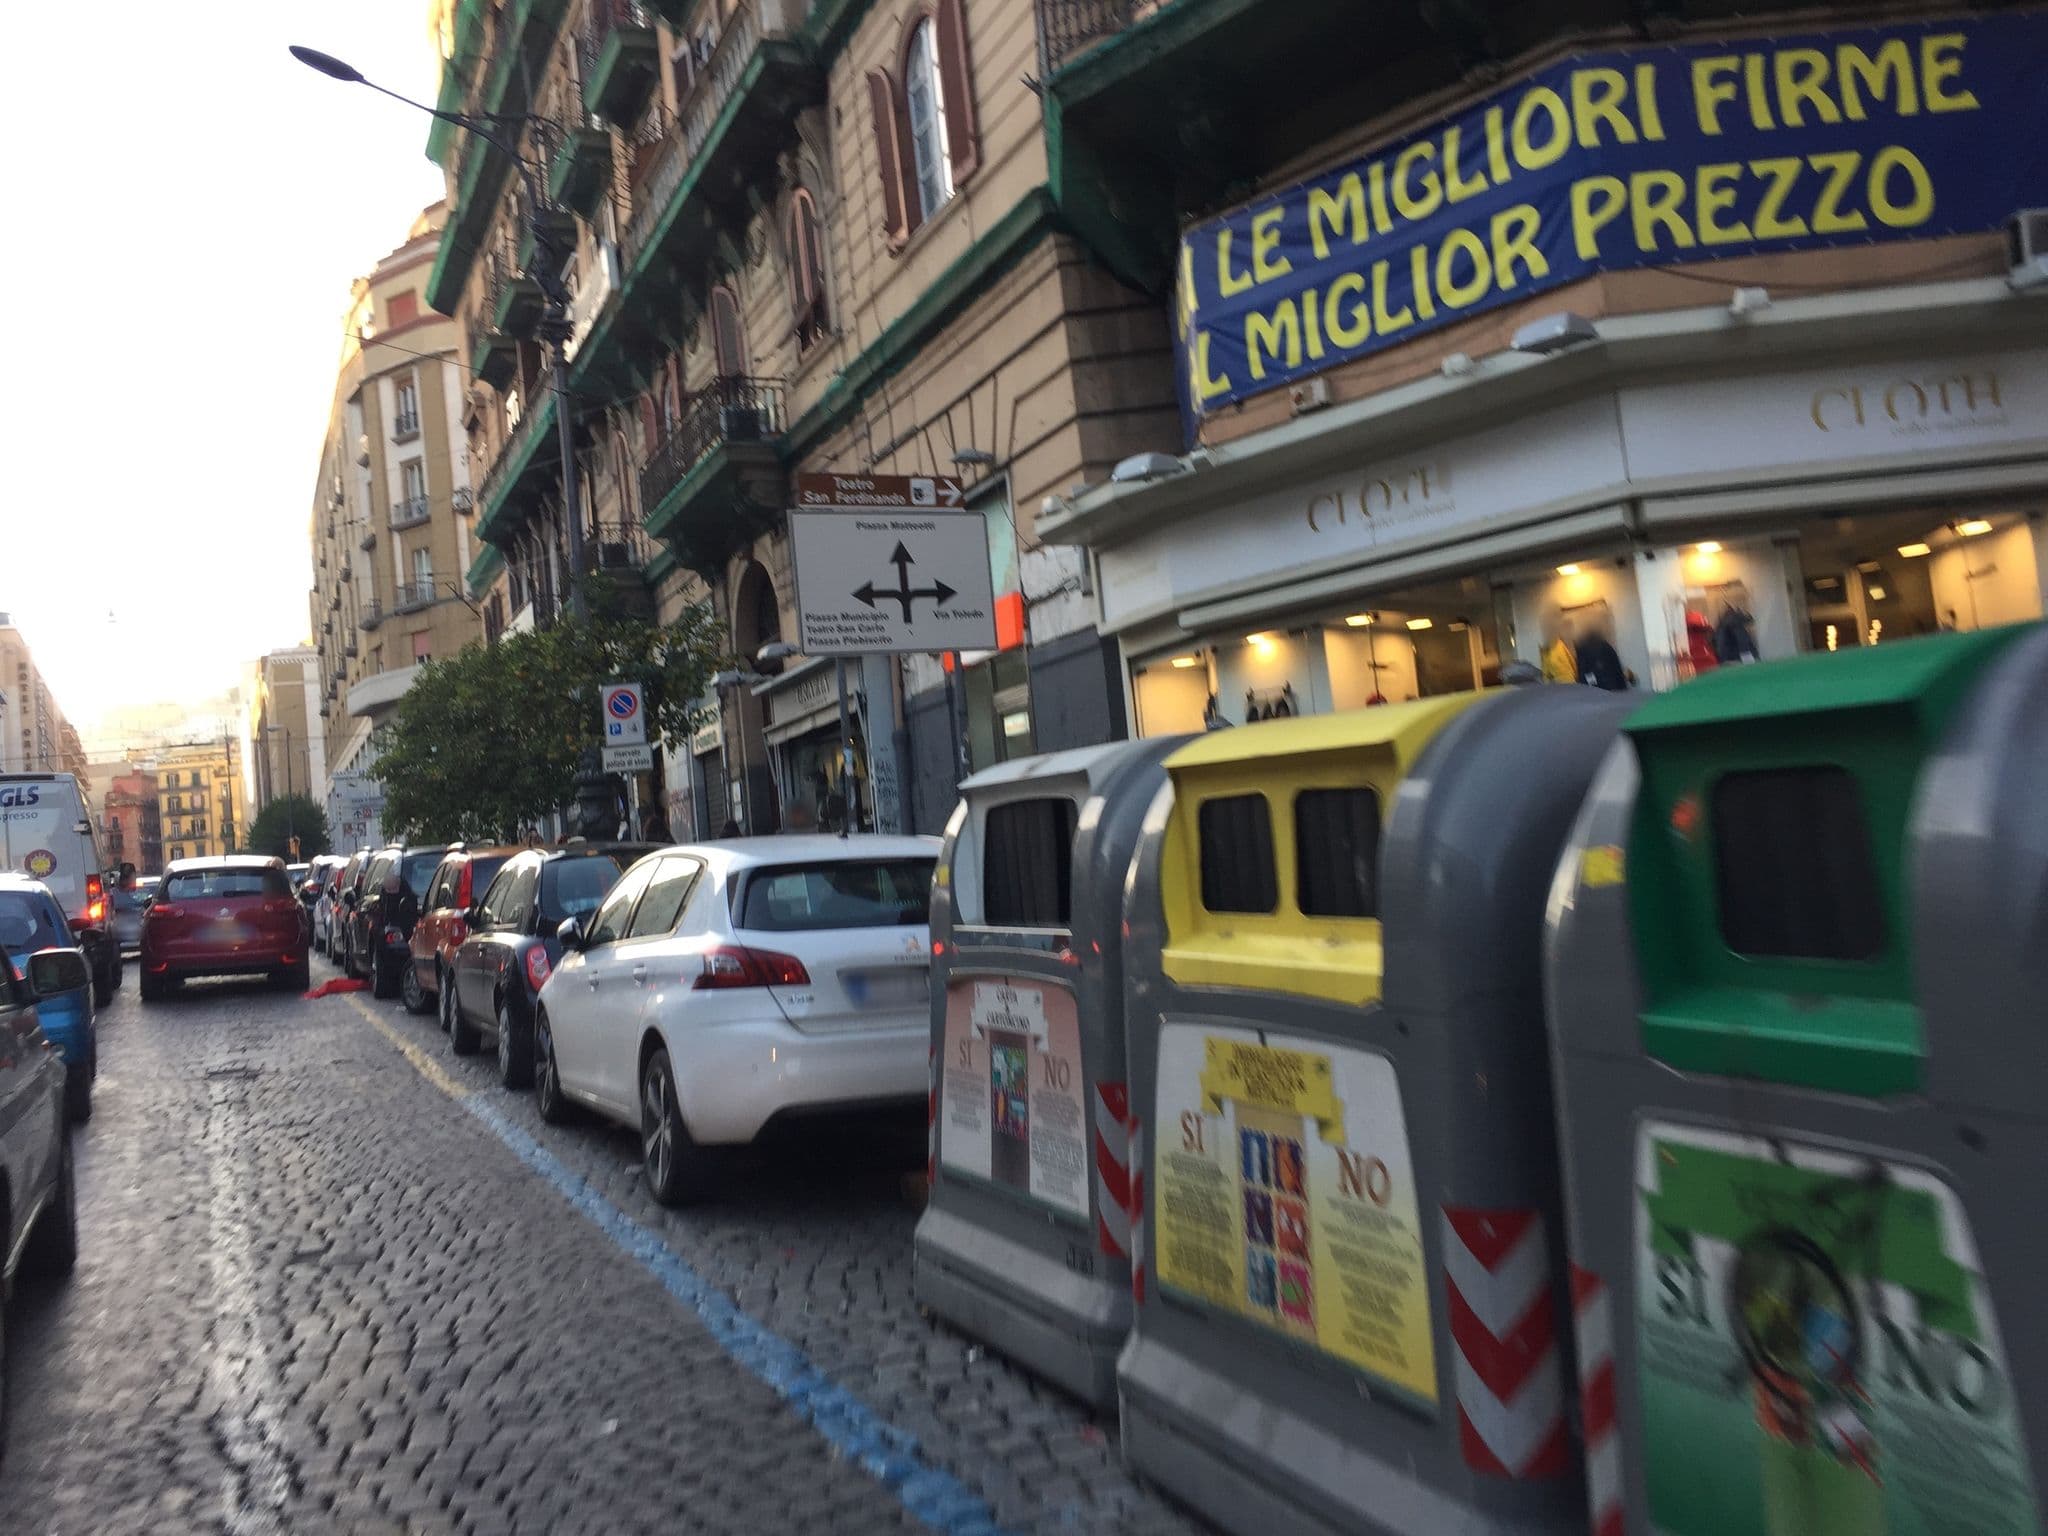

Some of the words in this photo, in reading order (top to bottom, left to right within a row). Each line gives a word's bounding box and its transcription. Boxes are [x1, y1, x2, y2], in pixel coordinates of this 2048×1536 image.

[1217, 206, 1294, 298] LE
[1307, 63, 1666, 260] MIGLIORI
[1691, 33, 1981, 135] FIRME
[1245, 204, 1550, 380] MIGLIOR
[1570, 145, 1936, 261] PREZZO
[1810, 370, 2001, 432] CLOTH
[832, 476, 875, 490] Teatro
[804, 490, 830, 504] San
[835, 490, 906, 505] Ferdinando
[856, 521, 888, 531] Piazza
[805, 612, 839, 622] Piazza
[841, 611, 889, 623] Municipio
[933, 610, 949, 619] Via
[952, 609, 984, 619] Toledo
[806, 625, 835, 634] Teatro
[837, 625, 855, 634] San
[858, 623, 885, 634] Carlo
[807, 636, 840, 647] Piazza
[843, 635, 892, 646] Plebiscito
[18, 662, 29, 714] HOTEL
[0, 786, 39, 807] GLS
[1044, 1056, 1071, 1089] NO
[1335, 1146, 1391, 1208] NO
[1873, 1312, 1996, 1413] NO
